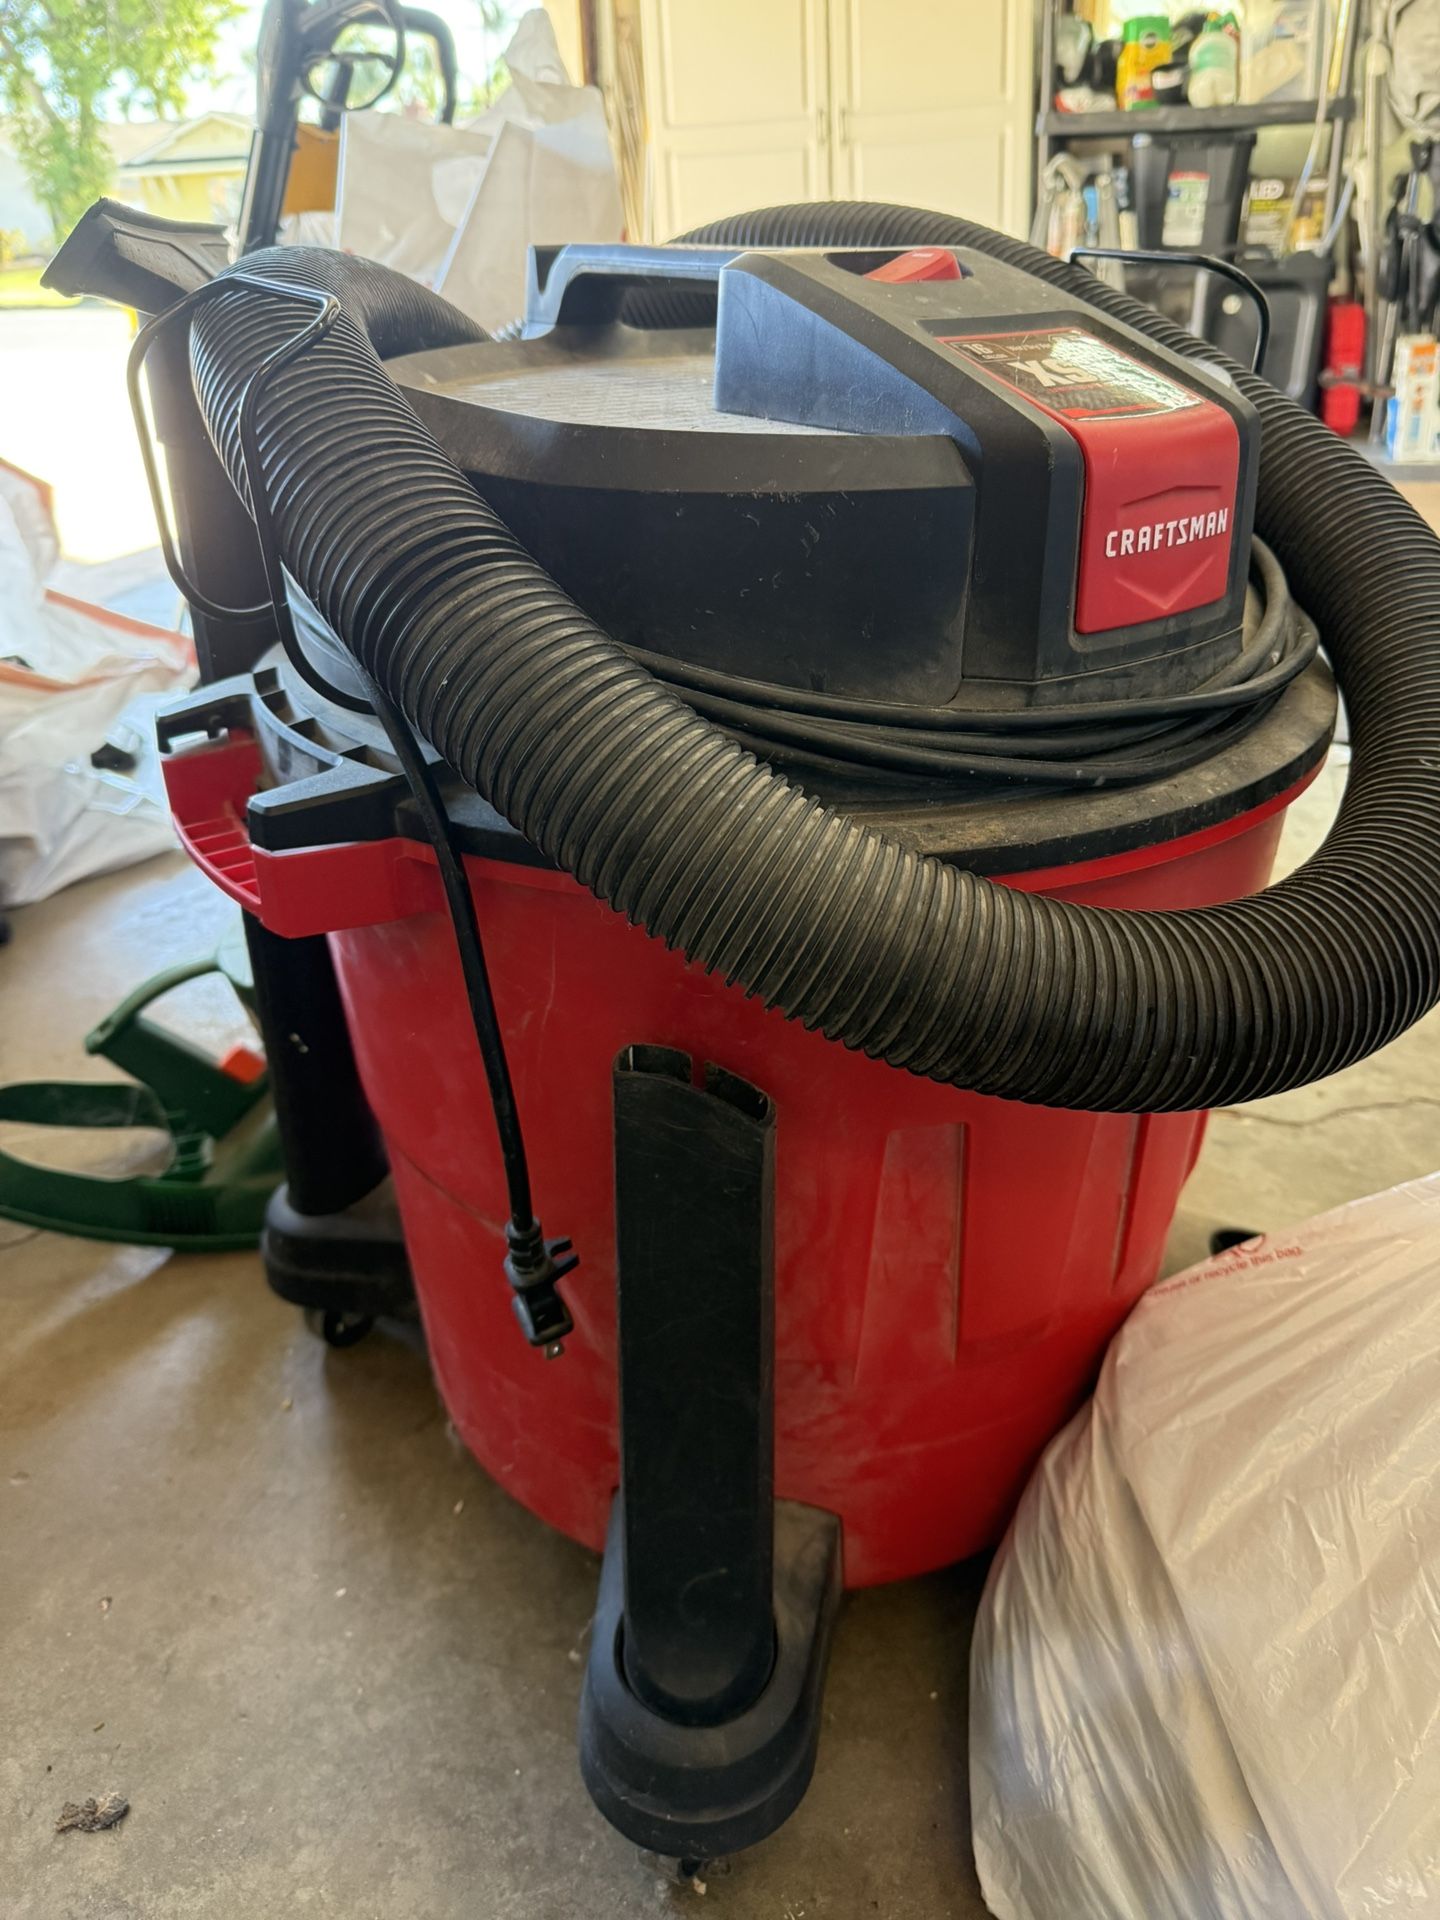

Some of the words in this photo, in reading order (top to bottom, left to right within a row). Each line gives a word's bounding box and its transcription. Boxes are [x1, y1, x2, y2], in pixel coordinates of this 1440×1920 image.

[1006, 358, 1104, 387] XS
[1105, 507, 1229, 558] CRAFTSMAN
[1204, 1261, 1248, 1279] recycle
[1250, 1254, 1274, 1267] this
